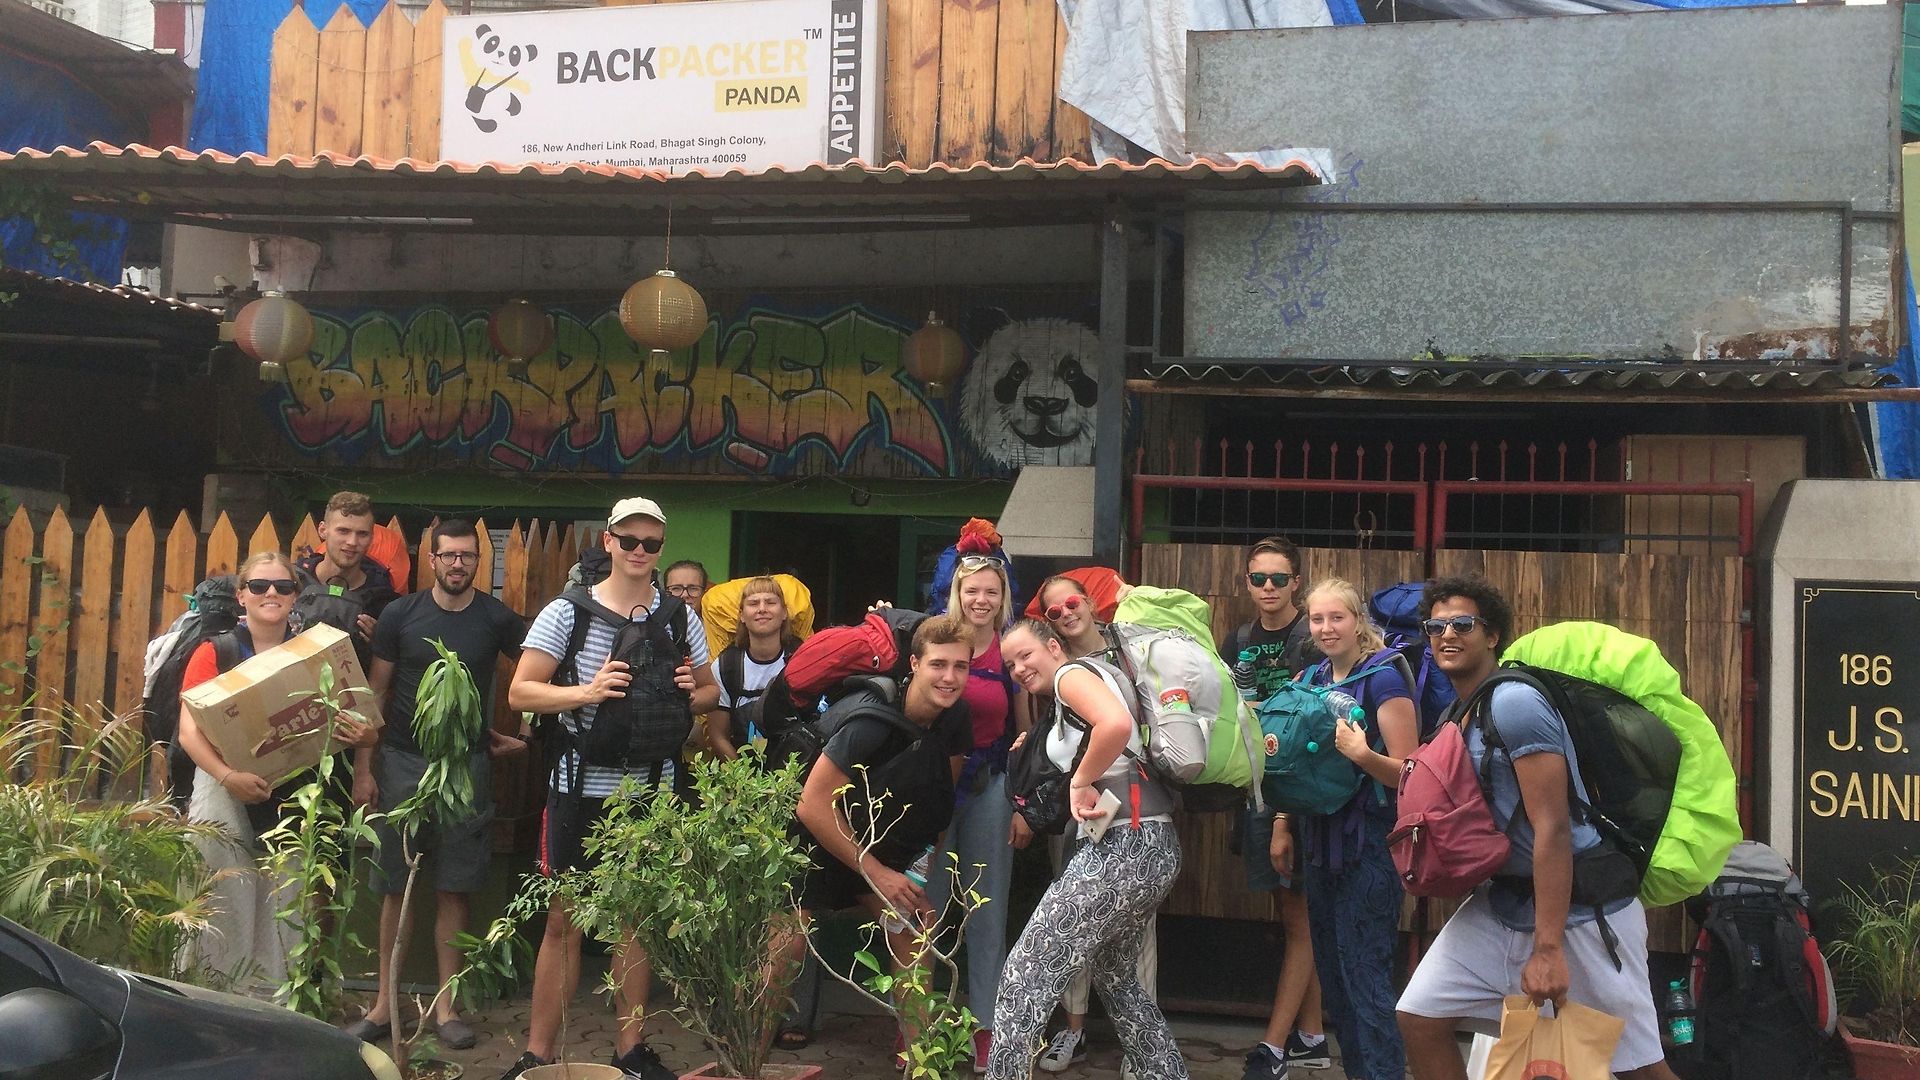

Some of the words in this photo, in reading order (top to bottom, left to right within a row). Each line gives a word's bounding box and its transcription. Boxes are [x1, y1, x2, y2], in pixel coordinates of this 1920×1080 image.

[803, 28, 823, 40] TM
[830, 11, 856, 154] APPETITE
[725, 85, 801, 107] PANDA
[522, 144, 540, 154] 186,
[543, 143, 564, 153] New
[566, 141, 604, 152] Andheri
[606, 140, 627, 150] Link
[629, 139, 658, 150] Road,
[660, 138, 695, 149] Bhagat
[697, 136, 726, 148] Singh
[729, 135, 766, 146] Colony,
[648, 155, 709, 166] Maharashtra
[711, 153, 747, 163] 400059
[1839, 653, 1892, 686] 186
[1810, 770, 1920, 821] SAINI
